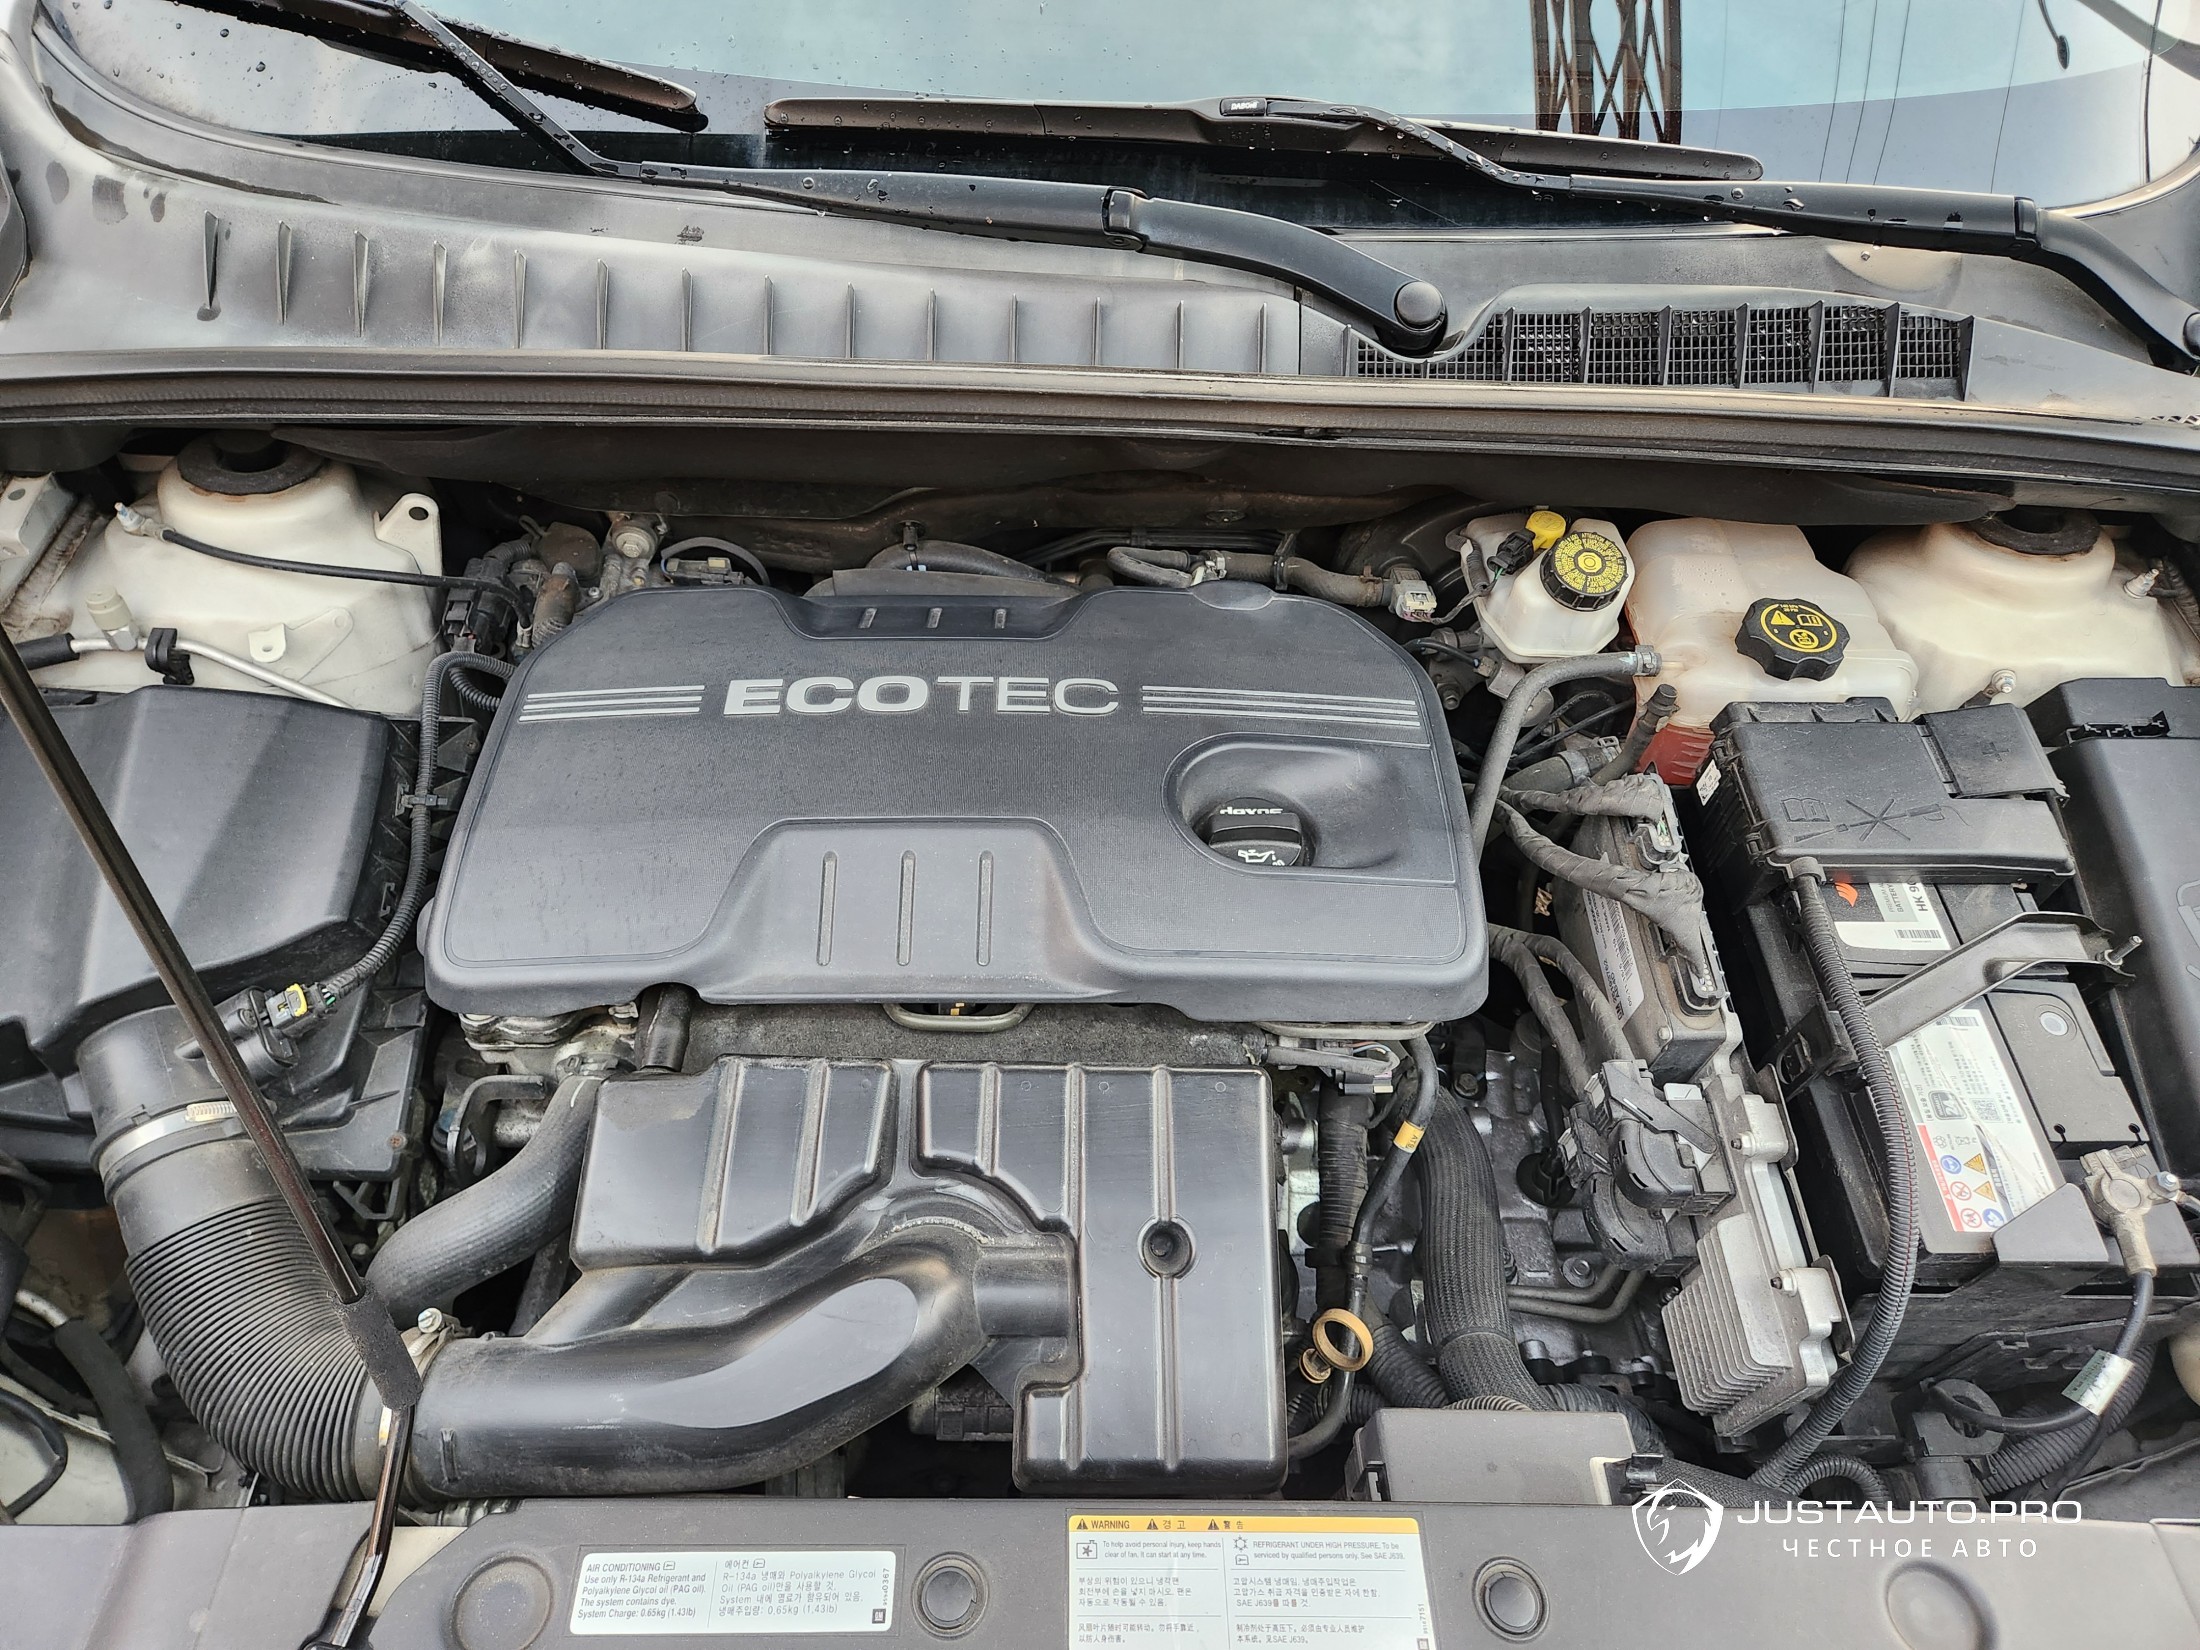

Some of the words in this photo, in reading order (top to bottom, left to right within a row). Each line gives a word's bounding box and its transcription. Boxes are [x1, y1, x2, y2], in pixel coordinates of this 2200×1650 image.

[723, 675, 1120, 716] ECOTEC
[1887, 883, 1904, 913] BATTERY
[1914, 896, 1928, 912] HK
[1091, 1520, 1130, 1529] WARNING
[1111, 1541, 1124, 1549] help
[1143, 1541, 1168, 1549] personal
[1188, 1541, 1202, 1549] keep
[1382, 1542, 1390, 1550] To
[1391, 1542, 1399, 1550] be
[1180, 1552, 1191, 1560] any
[1192, 1551, 1207, 1559] time.
[1254, 1552, 1280, 1560] serviced
[1281, 1552, 1289, 1561] by
[1290, 1552, 1317, 1561] qualified
[587, 1564, 601, 1573] AIR
[602, 1562, 661, 1572] CONDITIONING
[725, 1559, 749, 1570] 에어컨
[584, 1575, 599, 1584] Use
[601, 1575, 618, 1585] only
[620, 1574, 645, 1583] R-134a
[648, 1574, 690, 1585] Refrigerant
[692, 1573, 706, 1582] and
[723, 1572, 757, 1581] R-134a
[790, 1570, 845, 1581] Polyalkylene
[849, 1570, 876, 1580] Glycol
[582, 1586, 631, 1597] Polyalkylene
[633, 1585, 657, 1596] Glycol
[659, 1585, 668, 1594] oil
[671, 1585, 690, 1595] (PAG
[692, 1584, 706, 1595] oil).
[721, 1583, 734, 1593] Oil
[738, 1582, 758, 1593] (PAG
[797, 1581, 821, 1592] 사용할
[580, 1598, 594, 1607] The
[596, 1598, 624, 1608] system
[626, 1597, 659, 1606] contains
[661, 1597, 677, 1607] dye.
[720, 1596, 752, 1606] System
[757, 1594, 773, 1604] 내에
[1237, 1599, 1253, 1607] SAE
[578, 1610, 606, 1620] System
[608, 1609, 639, 1620] Charge:
[640, 1608, 666, 1619] 0.65kg
[668, 1608, 696, 1618] (1.43lb)
[768, 1605, 799, 1616] 0.65kg
[803, 1604, 838, 1615] (1.43lb)
